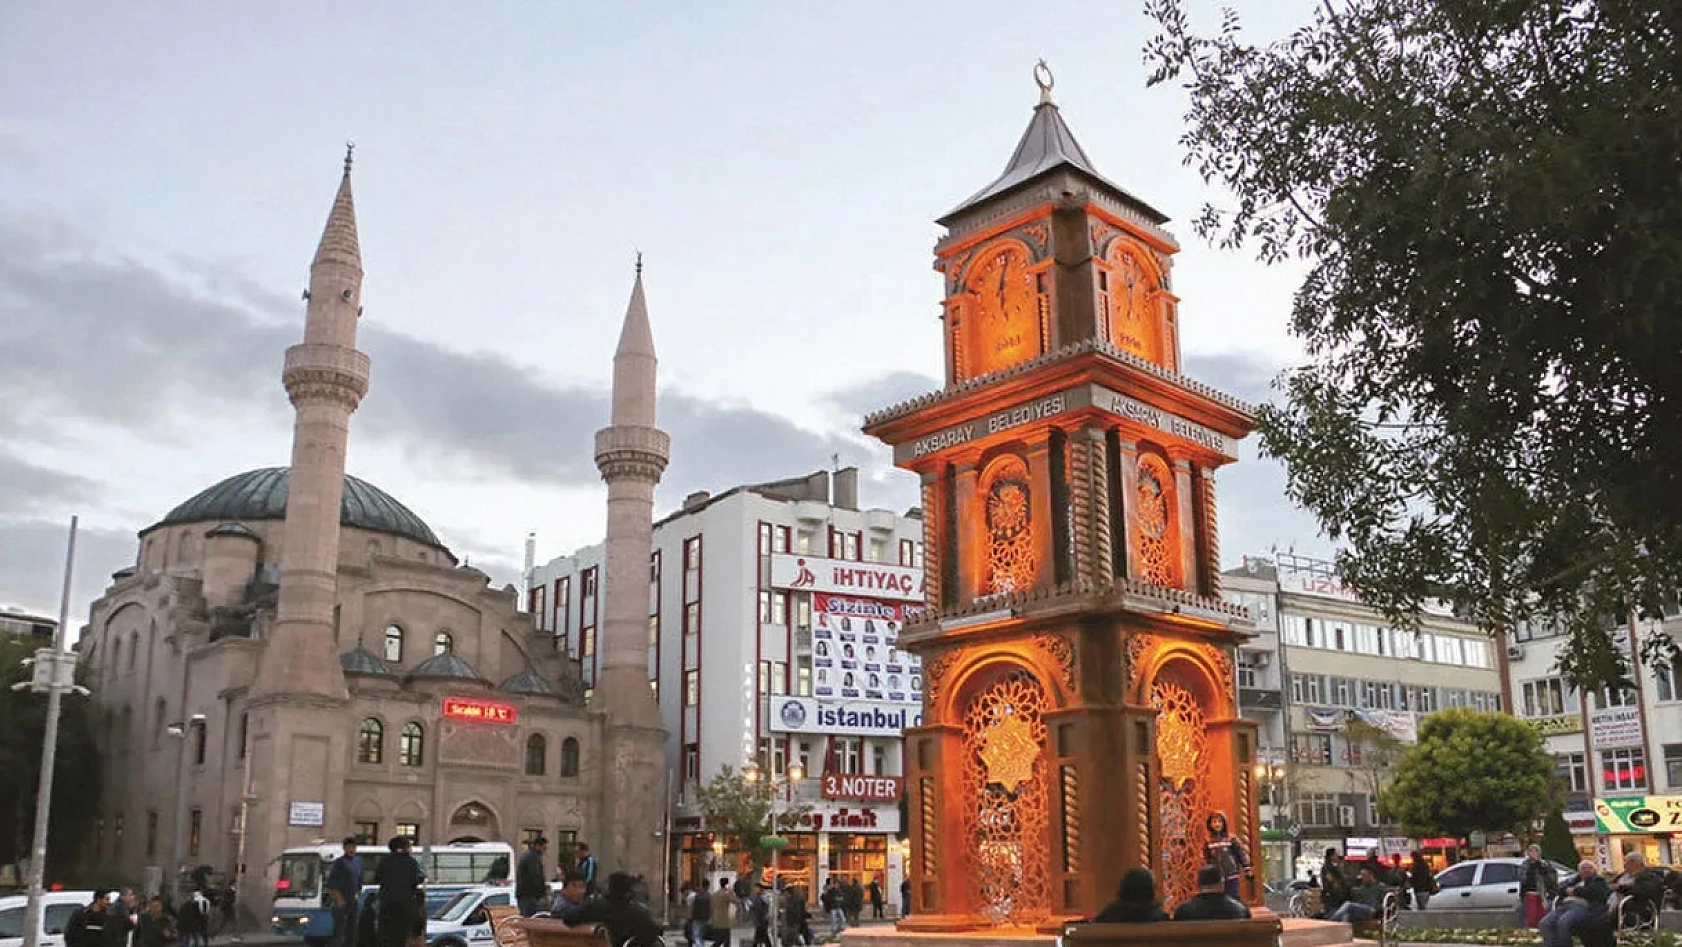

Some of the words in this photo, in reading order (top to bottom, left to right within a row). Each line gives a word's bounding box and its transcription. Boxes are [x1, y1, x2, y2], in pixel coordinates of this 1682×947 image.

[914, 424, 975, 457] AKSARAY
[817, 705, 907, 729] istanbul
[826, 776, 896, 798] 3.NOTER
